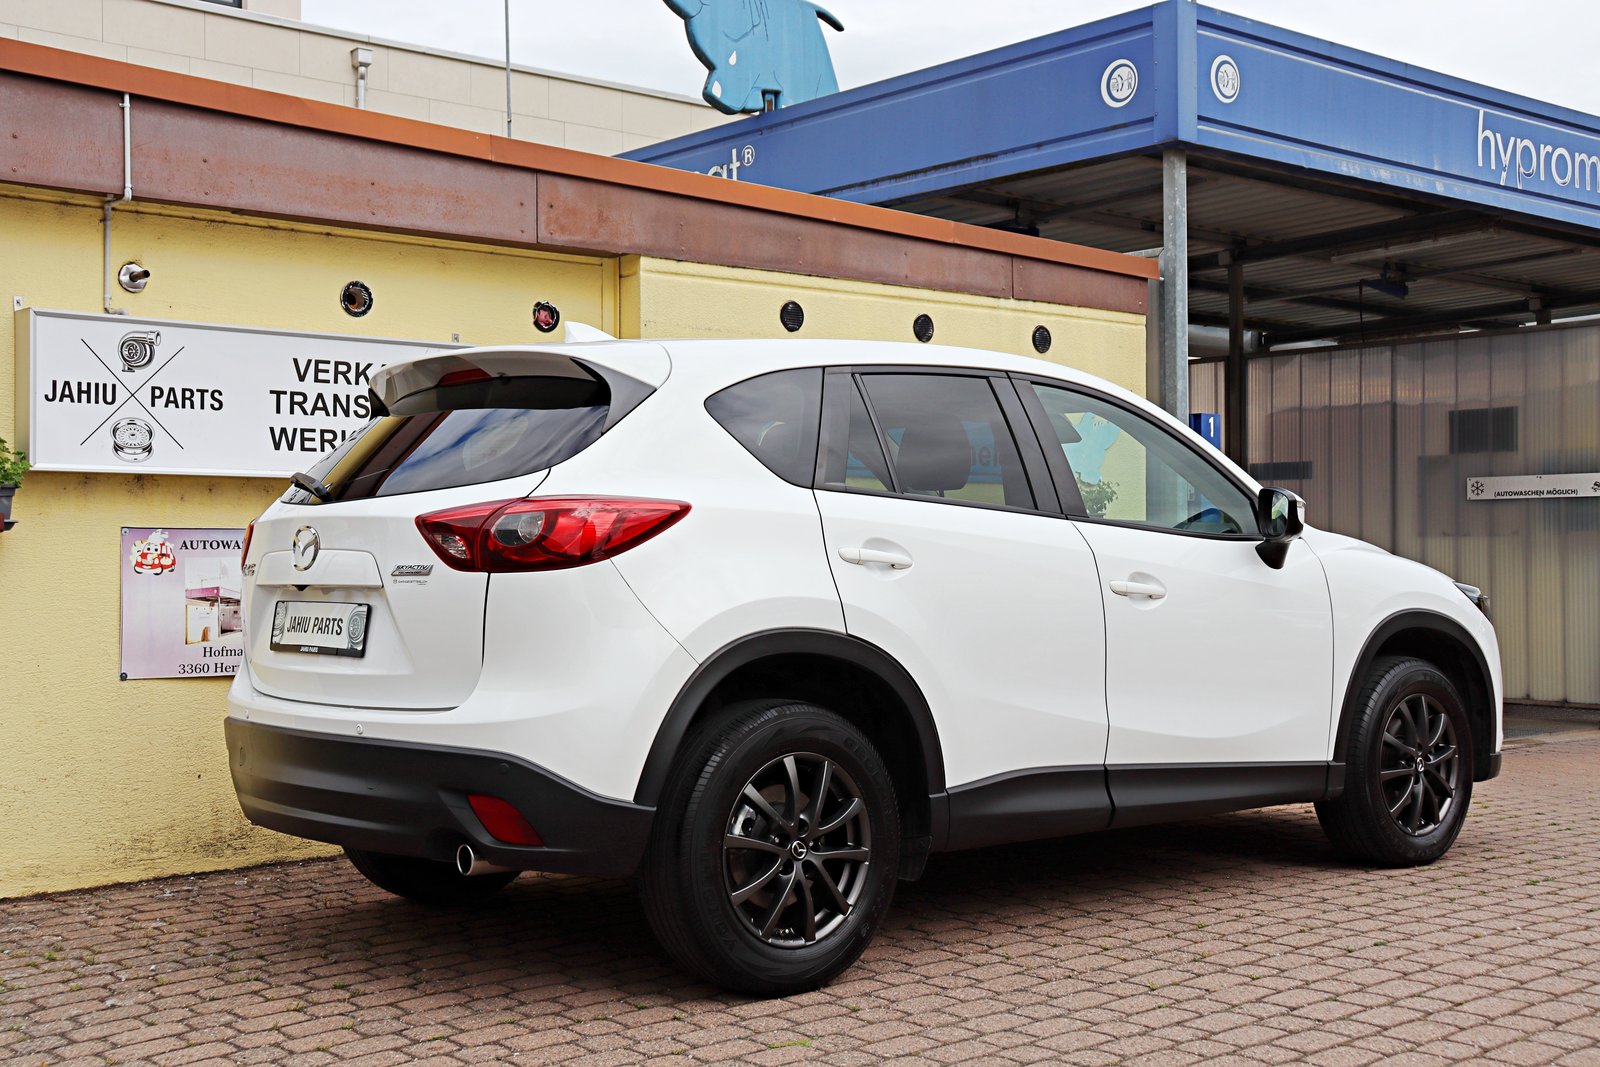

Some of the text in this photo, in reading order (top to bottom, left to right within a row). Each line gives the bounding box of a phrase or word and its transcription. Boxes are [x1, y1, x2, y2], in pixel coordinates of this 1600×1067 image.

[293, 357, 388, 386] VERK
[44, 379, 224, 411] JAHIU PARTS
[269, 389, 370, 419] TRANS
[1208, 416, 1215, 438] 1
[269, 426, 347, 453] WER
[1494, 489, 1545, 498] (AUTOWASCHEN
[179, 540, 244, 550] AUTOWA
[286, 616, 344, 636] JAHIU PARTS
[178, 662, 240, 675] 3360 Her
